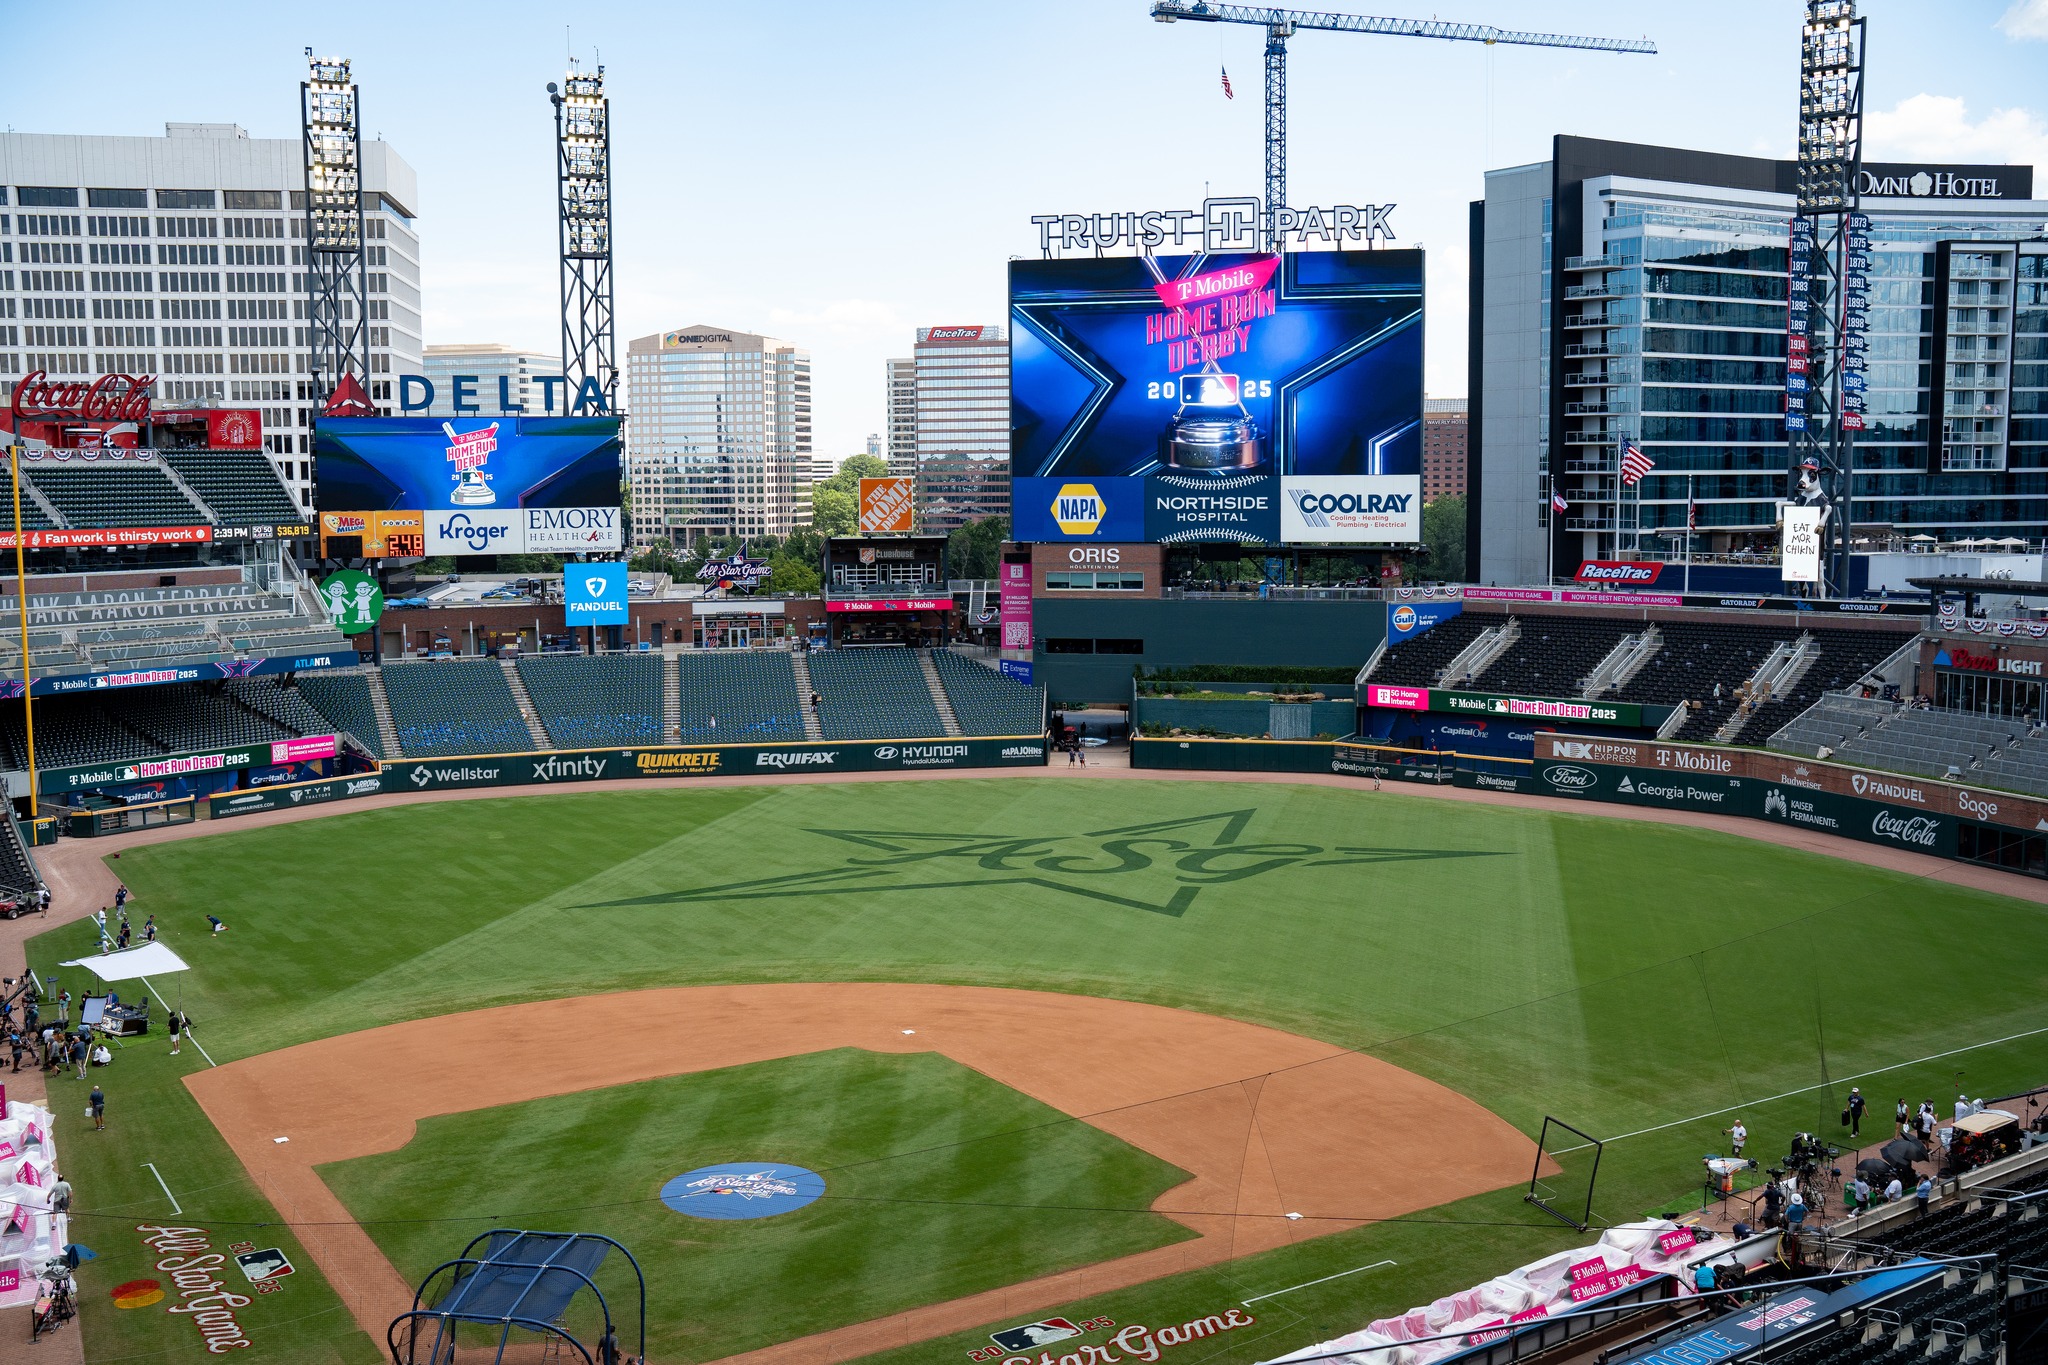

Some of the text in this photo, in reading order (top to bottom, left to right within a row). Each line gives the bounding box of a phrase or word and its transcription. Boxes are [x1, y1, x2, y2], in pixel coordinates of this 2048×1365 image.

[1852, 171, 2002, 197] OMNI HOTEL
[1274, 203, 1397, 243] PARK
[1794, 222, 1810, 232] 1872
[1850, 217, 1867, 228] 1873
[1031, 210, 1193, 250] TRUIST
[1793, 241, 1809, 252] 1874
[1850, 238, 1866, 248] 1875
[1792, 261, 1808, 272] 1877
[1849, 257, 1866, 268] 1878
[1195, 268, 1254, 297] Mobile
[1792, 280, 1808, 292] 1883
[1848, 278, 1865, 288] 1891
[1791, 300, 1808, 311] 1892
[1848, 297, 1864, 308] 1893
[1790, 320, 1807, 330] 1897
[1847, 317, 1865, 328] 1898
[678, 333, 732, 344] ONEDIGITAL
[931, 328, 978, 340] RaceTrac
[1790, 339, 1806, 350] 1914
[1846, 337, 1864, 348] 1948
[1790, 358, 1806, 370] 1957
[1846, 356, 1863, 368] 1958
[1789, 378, 1806, 389] 1969
[1845, 376, 1862, 388] 1982
[12, 370, 158, 420] Coca-Cola
[400, 374, 609, 411] DELTA
[1148, 380, 1272, 399] 20 25
[1788, 398, 1804, 408] 1991
[1844, 396, 1862, 408] 1992
[1788, 417, 1804, 428] 1993
[1844, 416, 1861, 428] 1995
[466, 432, 489, 442] Mobile
[865, 484, 887, 506] THE
[860, 478, 912, 531] HOME
[1060, 498, 1098, 520] NAPA
[1157, 496, 1268, 510] NORTHSIDE
[1300, 493, 1412, 514] COOLRAY
[528, 508, 616, 530] EMORY
[880, 498, 912, 531] DEPOT
[1177, 513, 1248, 522] HOSPITAL
[338, 516, 365, 527] MEGA
[1793, 522, 1811, 533] EAT
[214, 528, 248, 538] 2:39 PM
[276, 525, 310, 536] $36,819
[336, 525, 366, 534] MILLIONS
[440, 514, 508, 551] Kroger
[46, 530, 192, 544] Fan work is thirsty work
[530, 530, 612, 542] HEALTHCARE
[1792, 533, 1811, 544] MOR
[390, 536, 422, 550] 248
[1786, 544, 1815, 555] CHIKIN
[1069, 548, 1120, 564] ORIS
[696, 564, 772, 578] All Star Game
[1580, 564, 1653, 580] RaceTrac
[74, 590, 165, 620] AARON
[157, 586, 270, 614] TERRACE
[570, 602, 623, 612] FANDUEL
[1394, 614, 1415, 624] Gulf
[294, 657, 331, 668] ATLANTA
[1952, 648, 2044, 676] Coors LIGHT
[178, 670, 198, 679] 2025
[62, 680, 88, 690] Mobile
[1400, 690, 1418, 698] Home
[1390, 697, 1416, 706] Internet
[1458, 698, 1486, 710] Mobile
[1592, 708, 1616, 720] 2025
[902, 746, 968, 758] HYUNDAI
[1594, 744, 1637, 756] NIPPON
[226, 753, 250, 765] 2025
[636, 752, 721, 768] QUIKRETE
[756, 752, 835, 768] EQUIFAX
[1594, 753, 1637, 764] EXPRESS
[1674, 750, 1732, 772] Mobile
[532, 756, 608, 780] xfinity
[80, 771, 113, 784] Mobile
[434, 767, 500, 782] Wellstar
[1552, 768, 1588, 786] Ford
[1485, 776, 1516, 787] National
[1730, 780, 1740, 788] 375
[1781, 774, 1822, 790] Budweiser
[304, 786, 331, 795] TYM
[1638, 782, 1724, 802] Georgia Power
[1870, 782, 1926, 803] FANDUEL
[219, 802, 274, 814] BUILDSUBMARINES.COM
[1791, 800, 1814, 812] KAISER
[1958, 791, 1998, 822] Sage
[1790, 811, 1836, 828] PERMANENTE
[136, 1224, 212, 1254] All
[1670, 1233, 1693, 1248] Mobile
[229, 1242, 256, 1255] 20
[156, 1254, 227, 1298] Star
[1581, 1262, 1606, 1279] Mobile
[254, 1279, 284, 1295] 25
[1580, 1281, 1606, 1298] Mobile
[2014, 1298, 2028, 1312] BE
[167, 1291, 253, 1354] Game
[1108, 1308, 1256, 1362] Game
